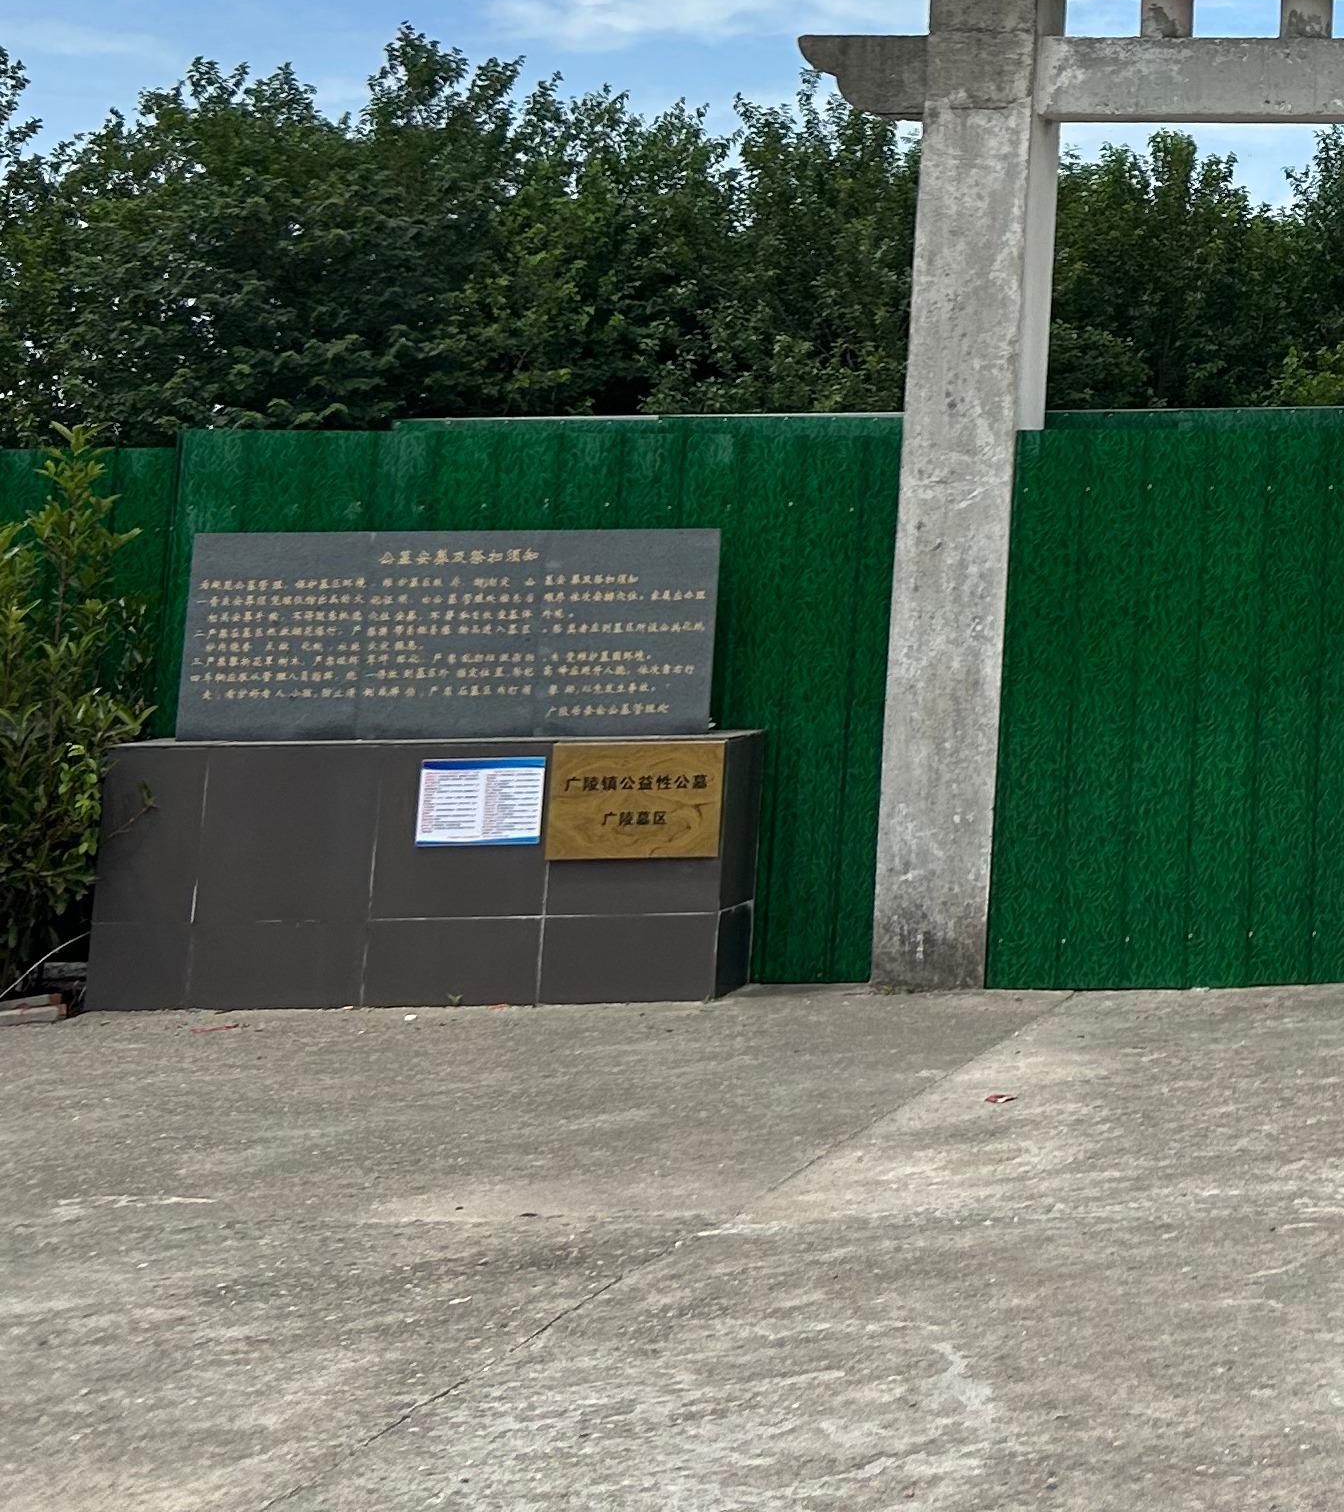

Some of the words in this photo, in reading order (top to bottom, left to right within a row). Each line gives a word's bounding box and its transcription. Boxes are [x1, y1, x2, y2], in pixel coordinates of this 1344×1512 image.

[564, 774, 709, 793] 广陵镇公益性公墓
[601, 809, 668, 828] 广陵墓区
